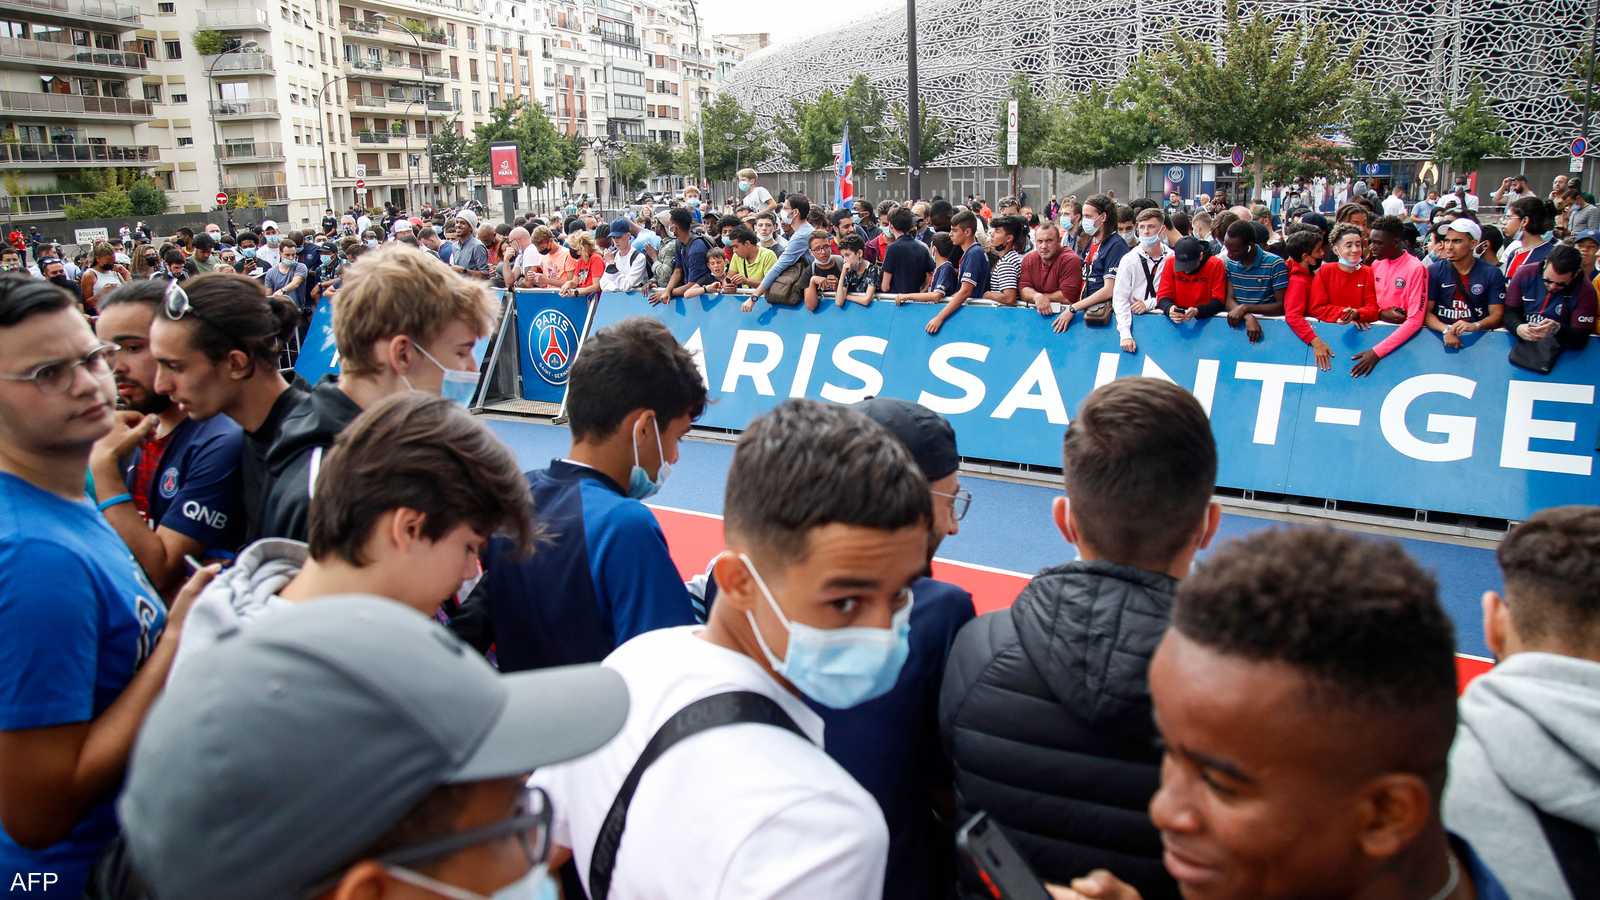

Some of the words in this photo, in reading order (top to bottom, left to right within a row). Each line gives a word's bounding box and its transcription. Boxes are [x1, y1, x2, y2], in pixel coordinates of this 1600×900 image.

[535, 312, 570, 332] PARIS
[1438, 304, 1484, 320] Emirats
[683, 327, 889, 404] ARIS
[182, 500, 228, 530] QNB
